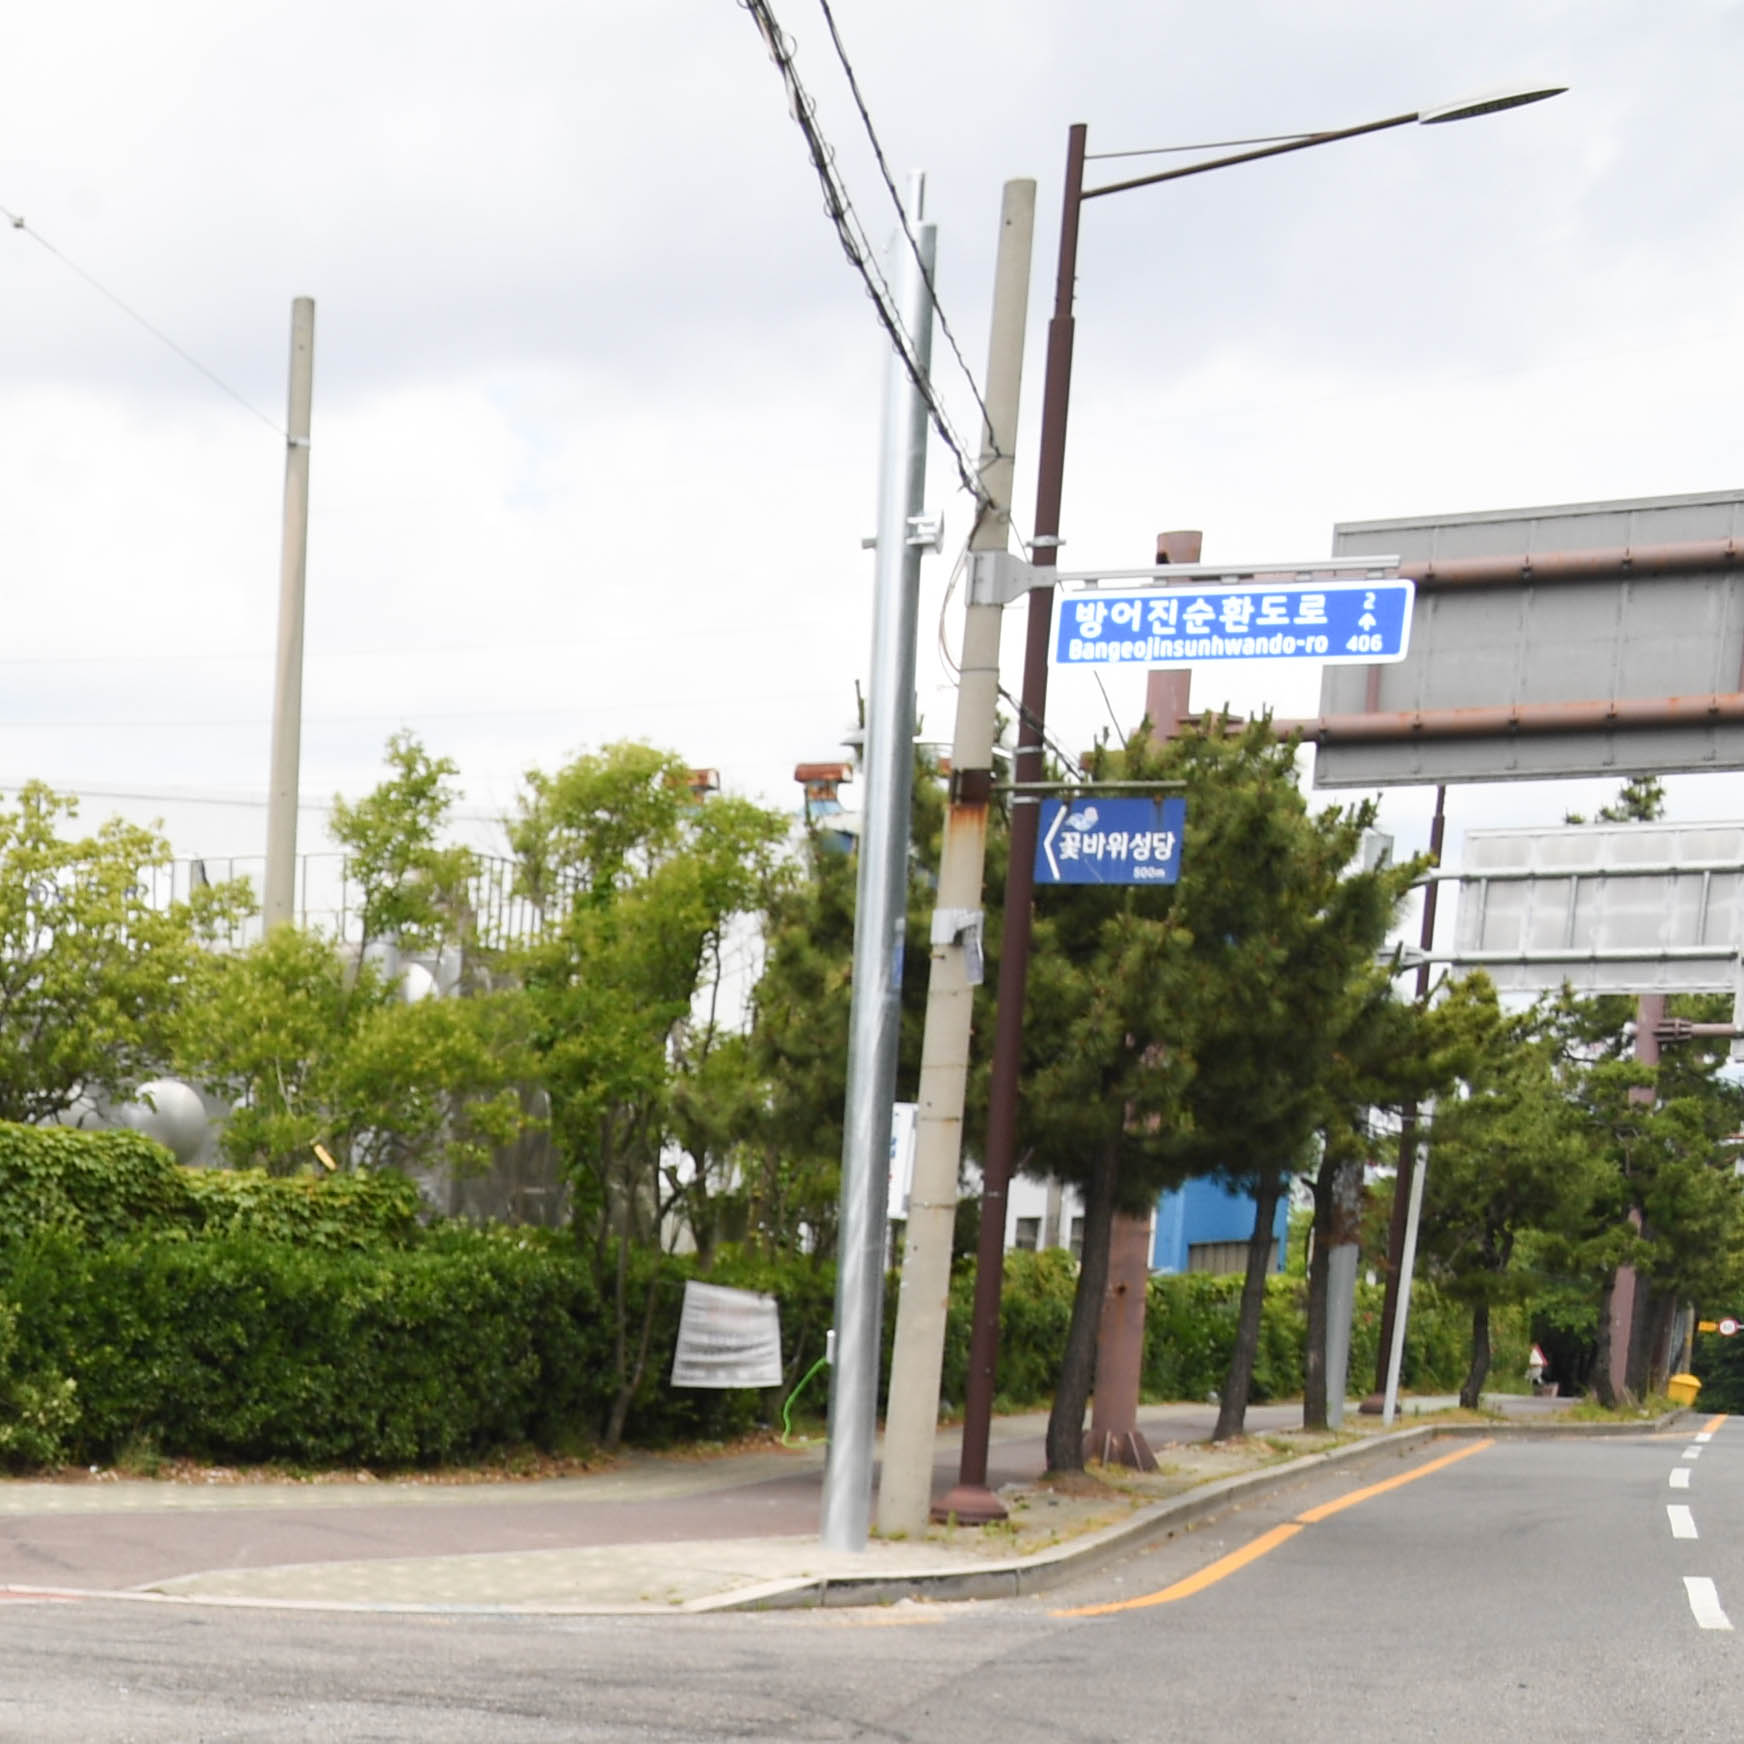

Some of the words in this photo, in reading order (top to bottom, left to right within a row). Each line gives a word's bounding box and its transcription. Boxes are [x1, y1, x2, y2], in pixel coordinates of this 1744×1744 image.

[1075, 593, 1328, 639] 방어진순환도로
[1364, 592, 1376, 610] 2
[1069, 632, 1329, 662] Bangeojinsunhwando-ro
[1346, 635, 1383, 652] 406
[1058, 831, 1176, 861] 꽃바위성당
